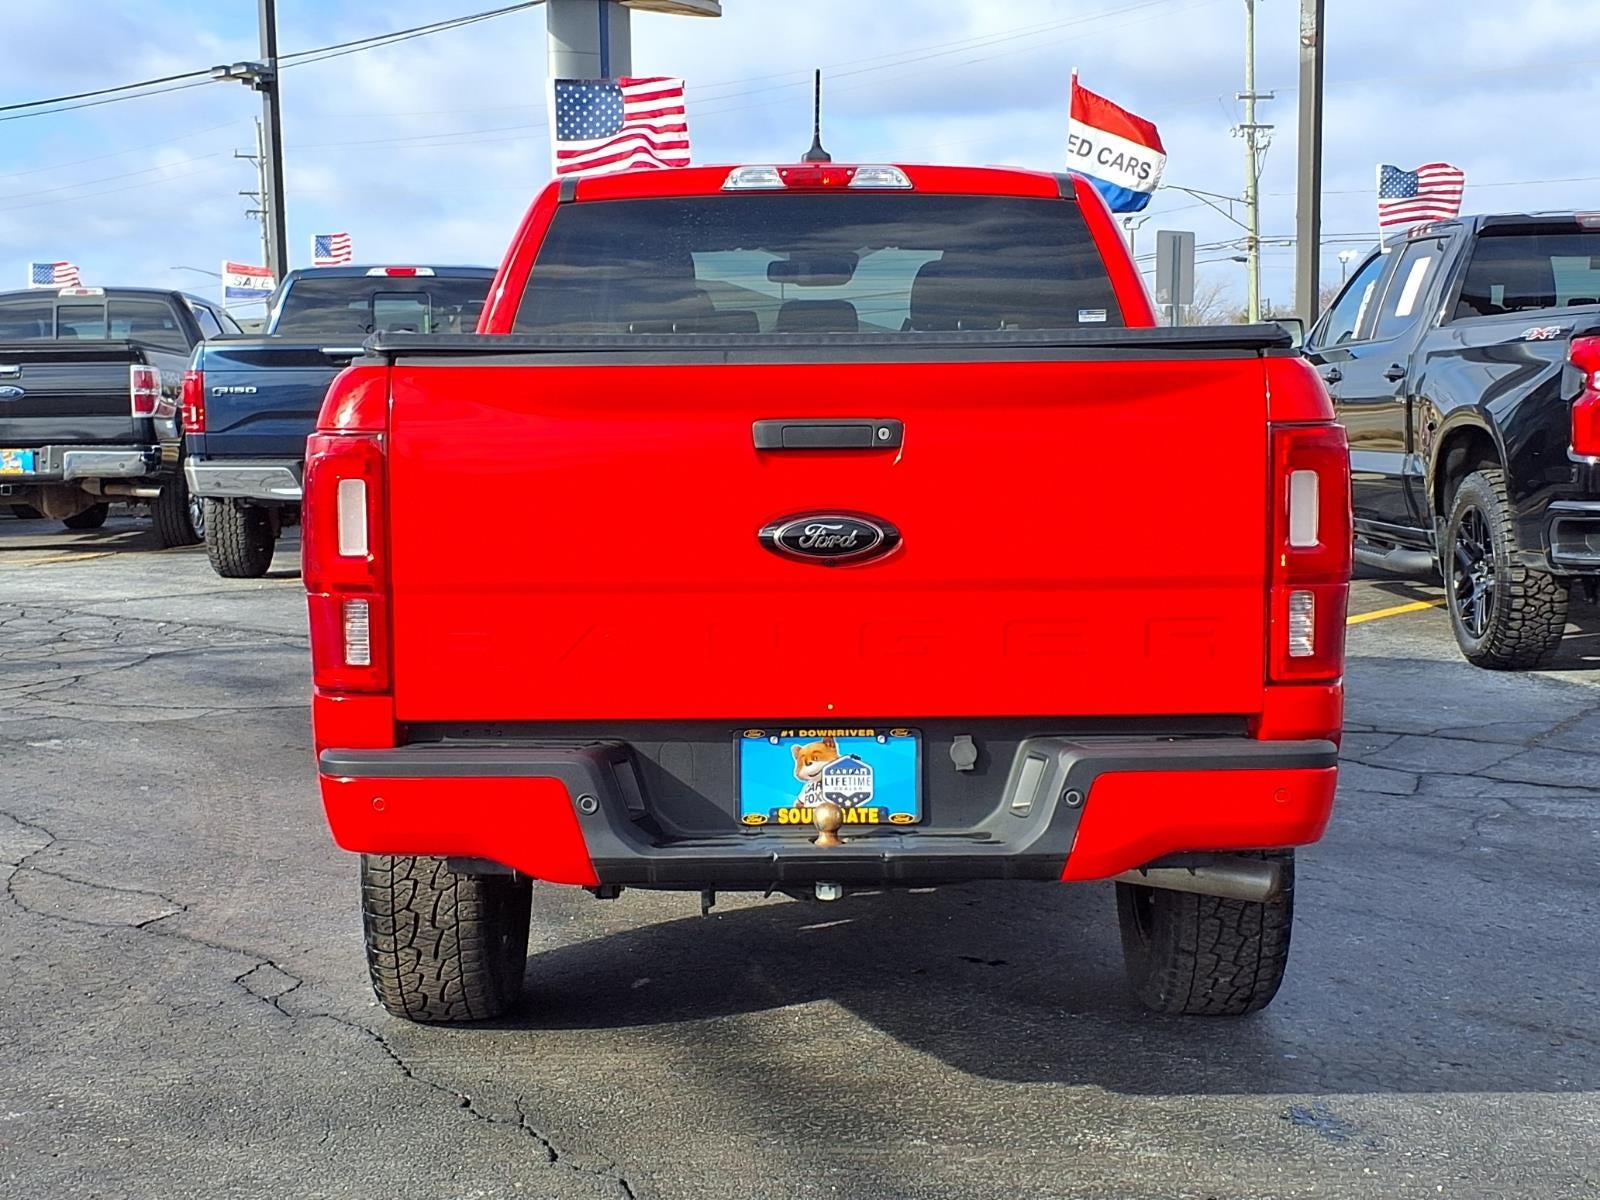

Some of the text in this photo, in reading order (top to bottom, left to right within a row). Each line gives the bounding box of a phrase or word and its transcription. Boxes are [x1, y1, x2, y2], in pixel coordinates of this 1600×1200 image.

[1097, 147, 1152, 180] CARS
[233, 276, 270, 288] SALE
[799, 523, 858, 549] Ford
[799, 729, 875, 737] DOWNRIVER
[825, 776, 871, 786] LIFETIME
[778, 807, 879, 824] SOUATE
